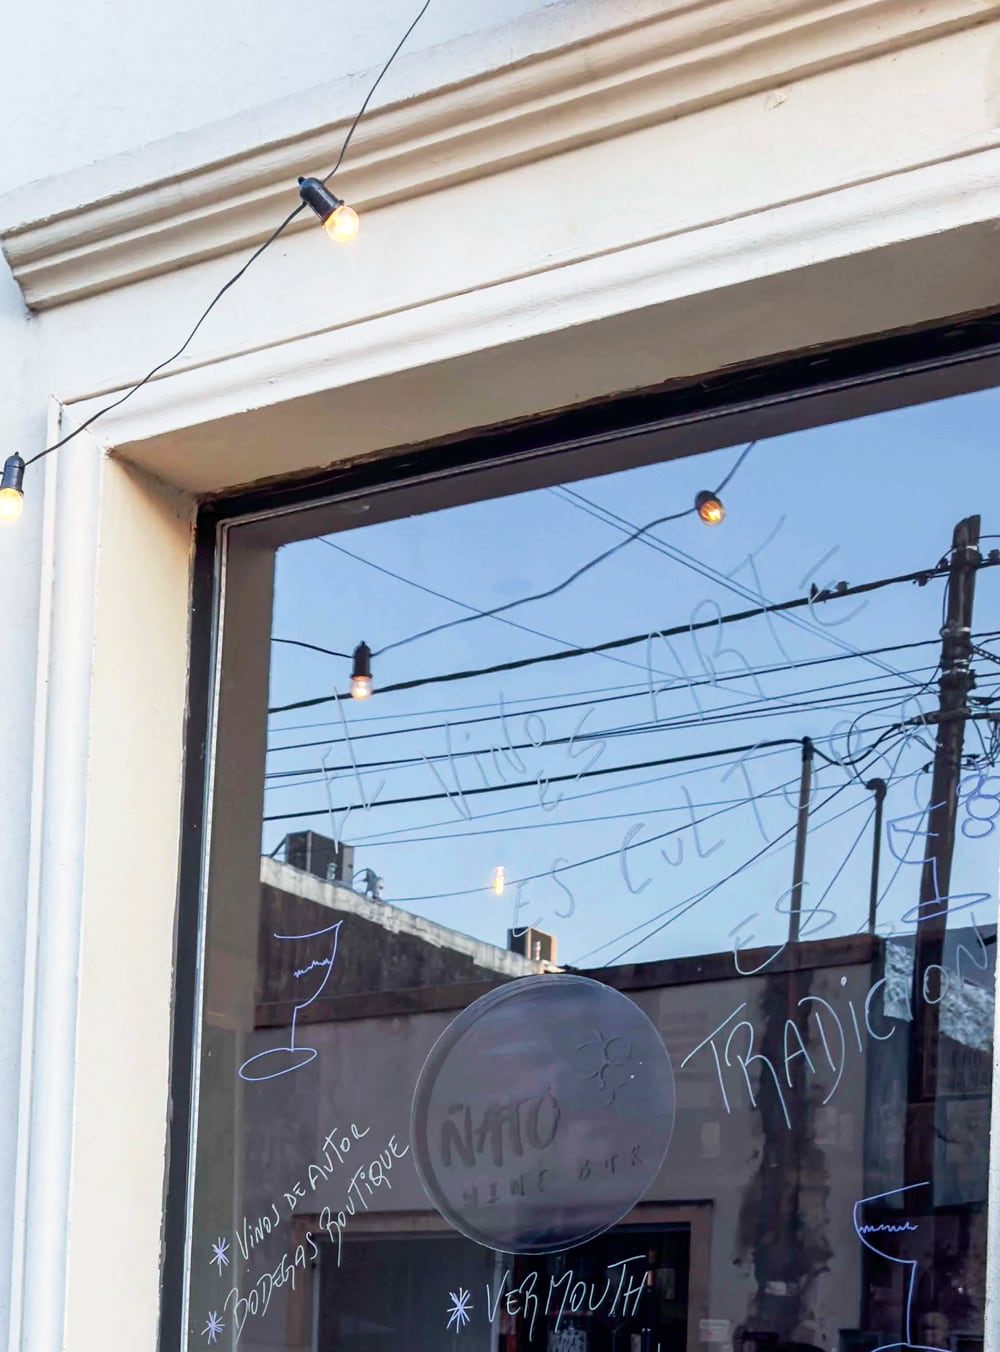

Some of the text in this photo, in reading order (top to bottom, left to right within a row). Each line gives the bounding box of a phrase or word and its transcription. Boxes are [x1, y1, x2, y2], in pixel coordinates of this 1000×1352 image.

[646, 514, 870, 725] ARTE
[513, 857, 577, 938] ES
[728, 882, 836, 976] ES
[283, 1181, 306, 1210] DE
[308, 1123, 371, 1191] AUTOR
[223, 1231, 318, 1345] BODEGAS
[485, 1254, 649, 1342] VERMOUTH
